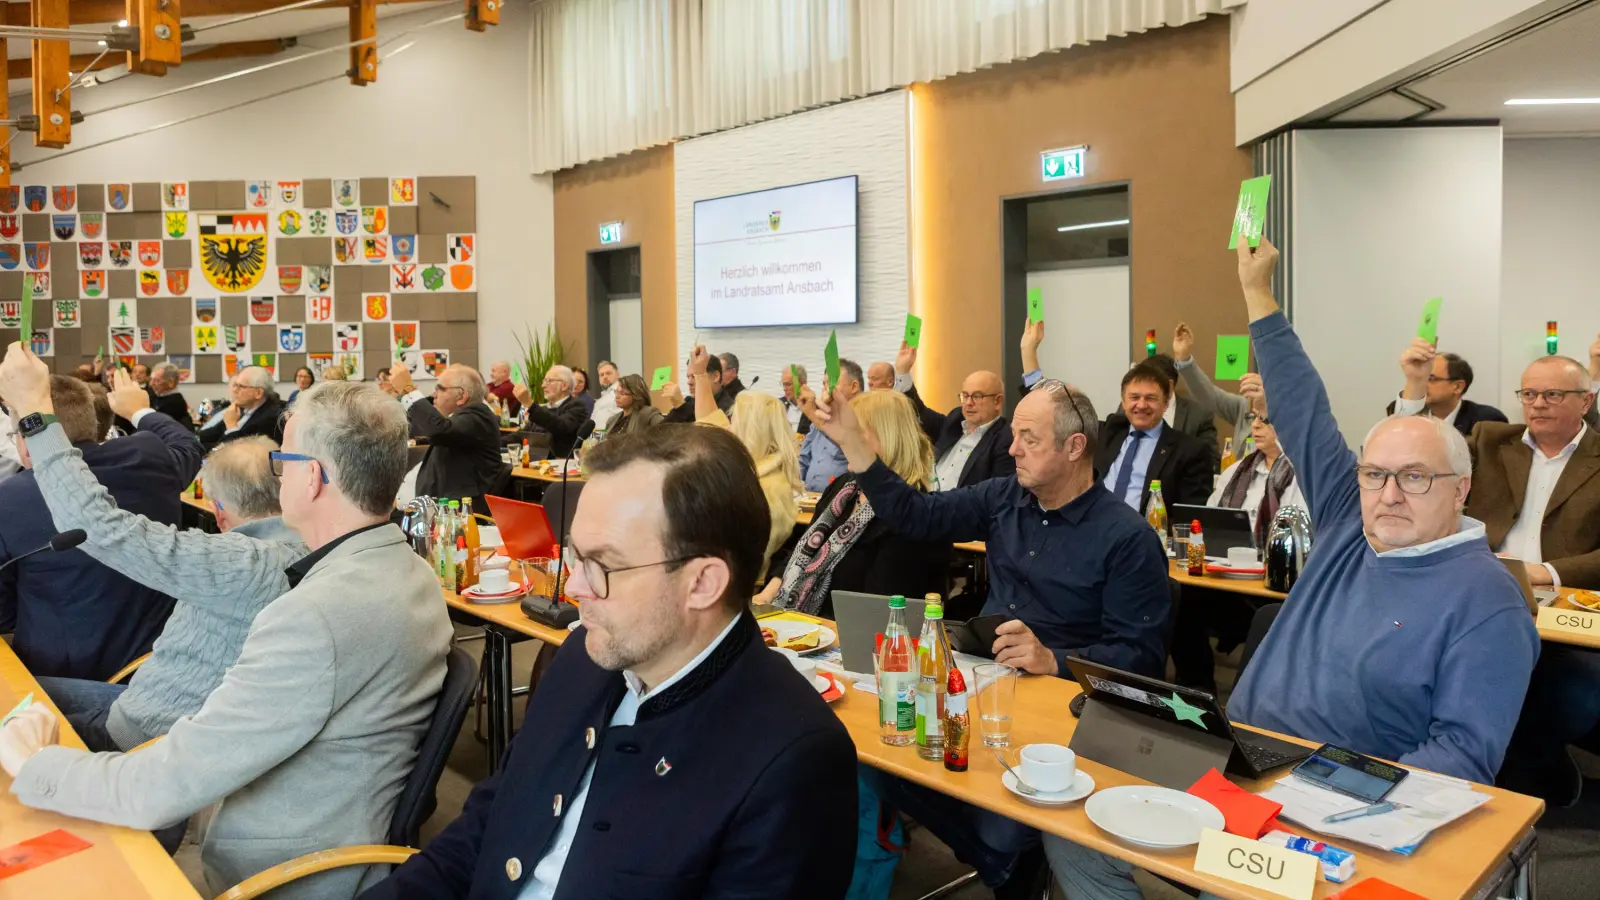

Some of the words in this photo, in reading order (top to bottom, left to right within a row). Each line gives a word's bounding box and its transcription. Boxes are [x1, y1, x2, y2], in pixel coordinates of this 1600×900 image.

[720, 263, 759, 280] Herzlich
[761, 260, 822, 277] willkommen
[711, 286, 723, 300] im
[724, 282, 784, 299] Landratsamt
[787, 278, 834, 295] Ansbach
[1556, 614, 1593, 629] CSU
[1227, 847, 1285, 880] CSU
